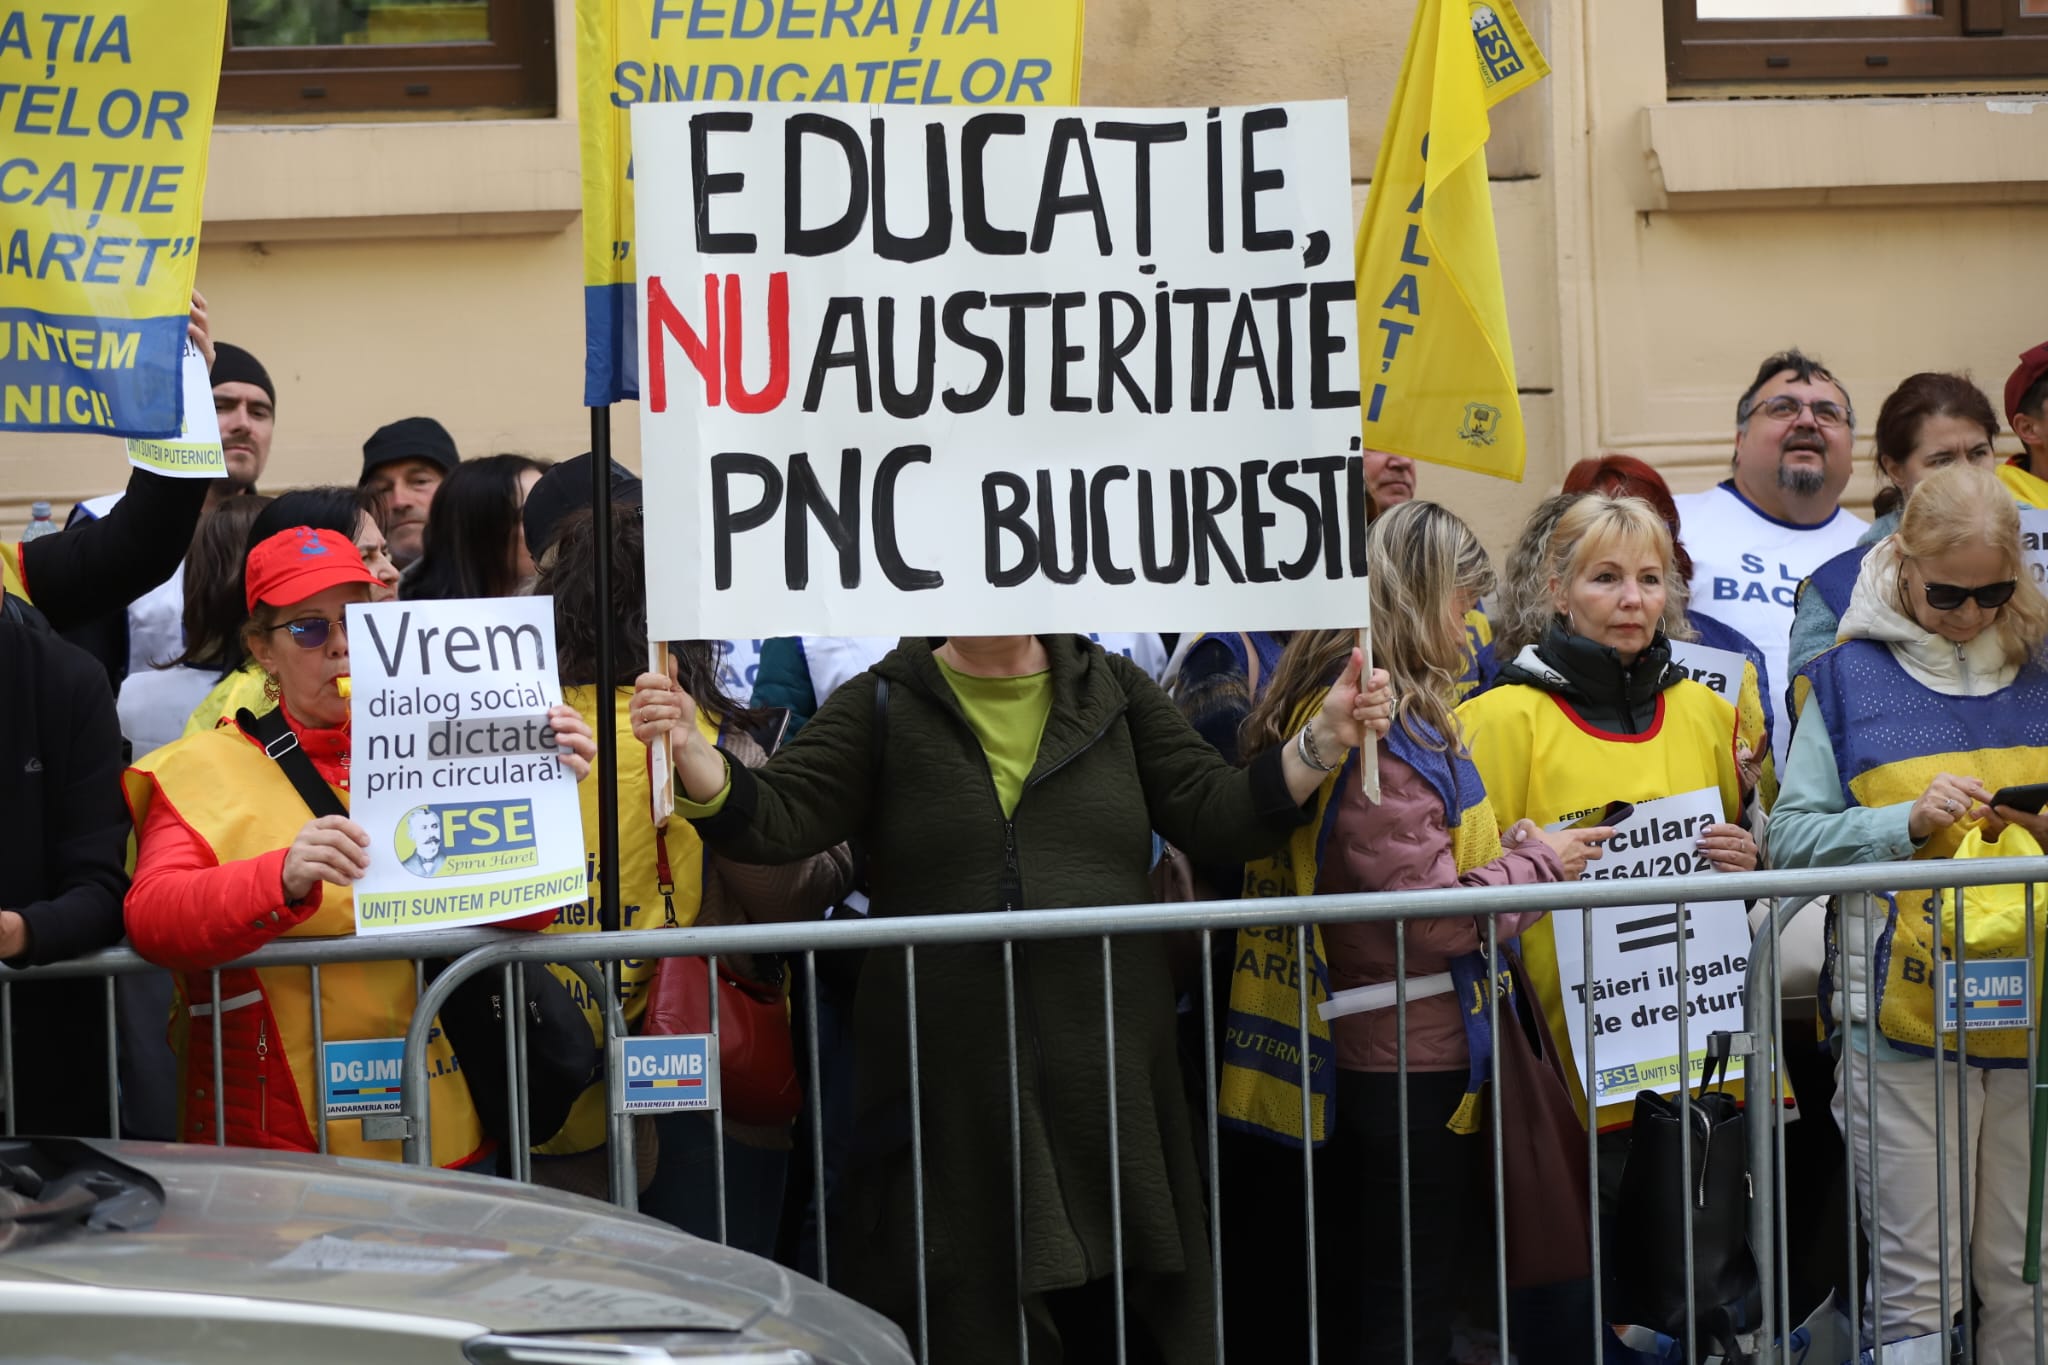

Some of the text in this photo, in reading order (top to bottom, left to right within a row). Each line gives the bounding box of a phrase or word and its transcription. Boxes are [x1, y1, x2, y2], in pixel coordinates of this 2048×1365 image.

[1477, 24, 1520, 79] FSE
[647, 271, 1362, 419] NU AUSTERITATE
[710, 445, 944, 591] PNC
[363, 611, 545, 678] Vrem
[369, 681, 553, 720] dialog social,
[368, 719, 559, 761] nu dictate
[367, 755, 562, 800] prin circulară!
[441, 804, 533, 848] FSE
[447, 857, 487, 874] Spiru
[362, 874, 584, 924] UNIȚI SUNTEM PUTERNICI!
[330, 1058, 402, 1082] DGJM
[627, 1054, 703, 1077] DGJMB
[327, 1103, 382, 1113] JANDARMERIA
